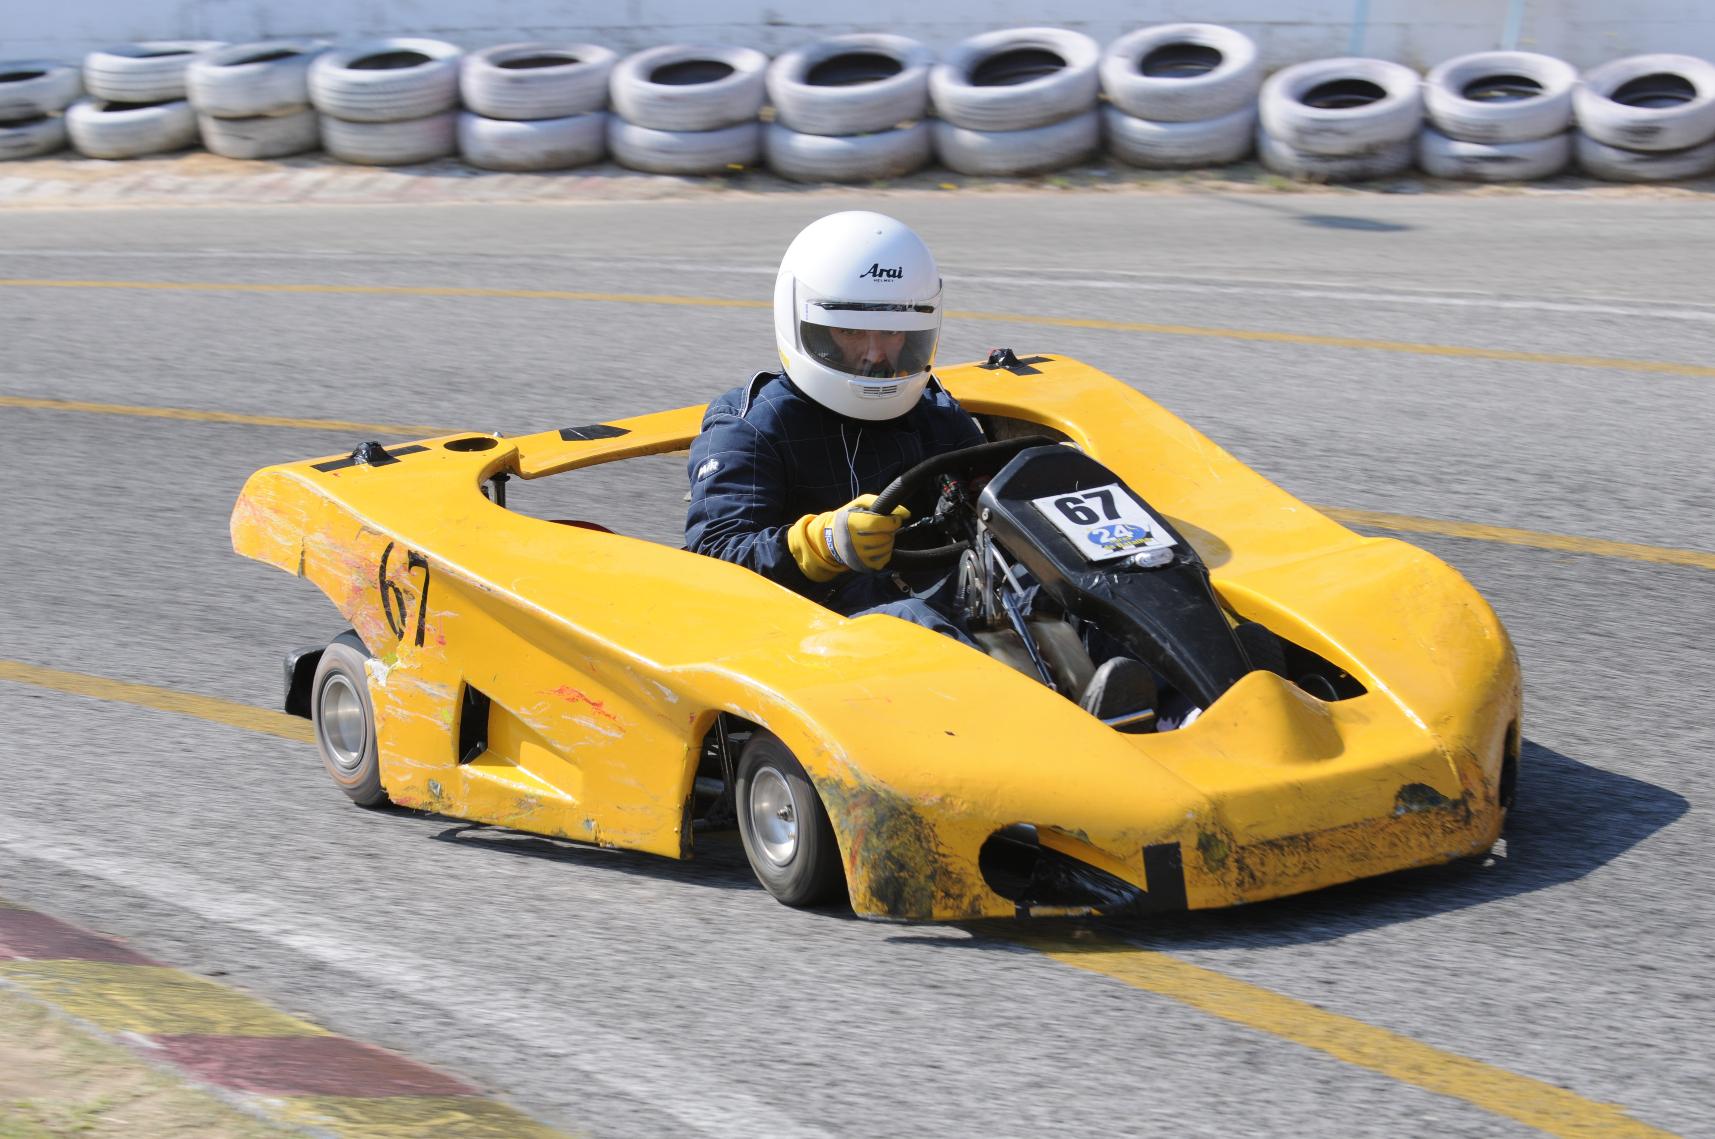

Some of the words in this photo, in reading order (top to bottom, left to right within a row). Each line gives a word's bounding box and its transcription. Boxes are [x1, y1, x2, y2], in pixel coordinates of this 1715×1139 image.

[860, 263, 903, 279] Arai
[1055, 489, 1121, 526] 67
[1092, 525, 1135, 543] 24
[379, 541, 430, 648] 67
